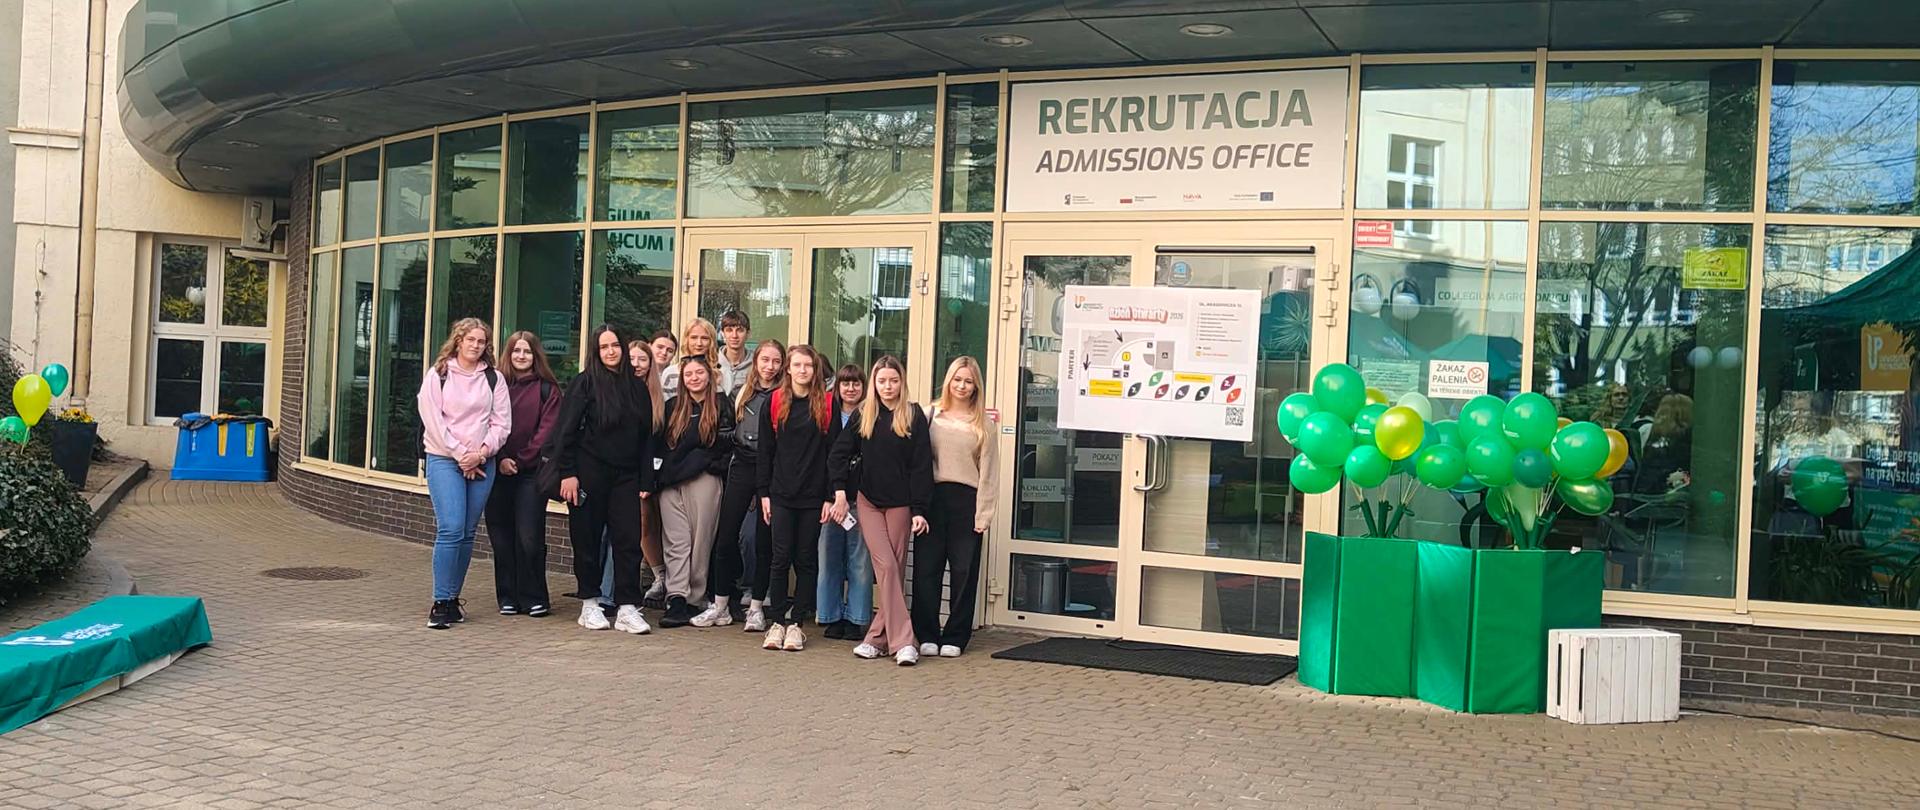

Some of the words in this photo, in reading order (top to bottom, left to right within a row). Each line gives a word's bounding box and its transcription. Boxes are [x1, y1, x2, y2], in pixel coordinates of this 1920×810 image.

[1038, 89, 1313, 135] REKRUTACJA
[1035, 146, 1206, 173] ADMISSIONS
[1211, 143, 1314, 170] OFFICE
[1438, 291, 1495, 301] COLLEGIUM
[1067, 350, 1075, 380] PARTER
[1436, 363, 1465, 373] ZAKAZ
[1432, 375, 1468, 384] PALENIA
[1092, 453, 1120, 461] POKAZY
[1865, 467, 1875, 480] na
